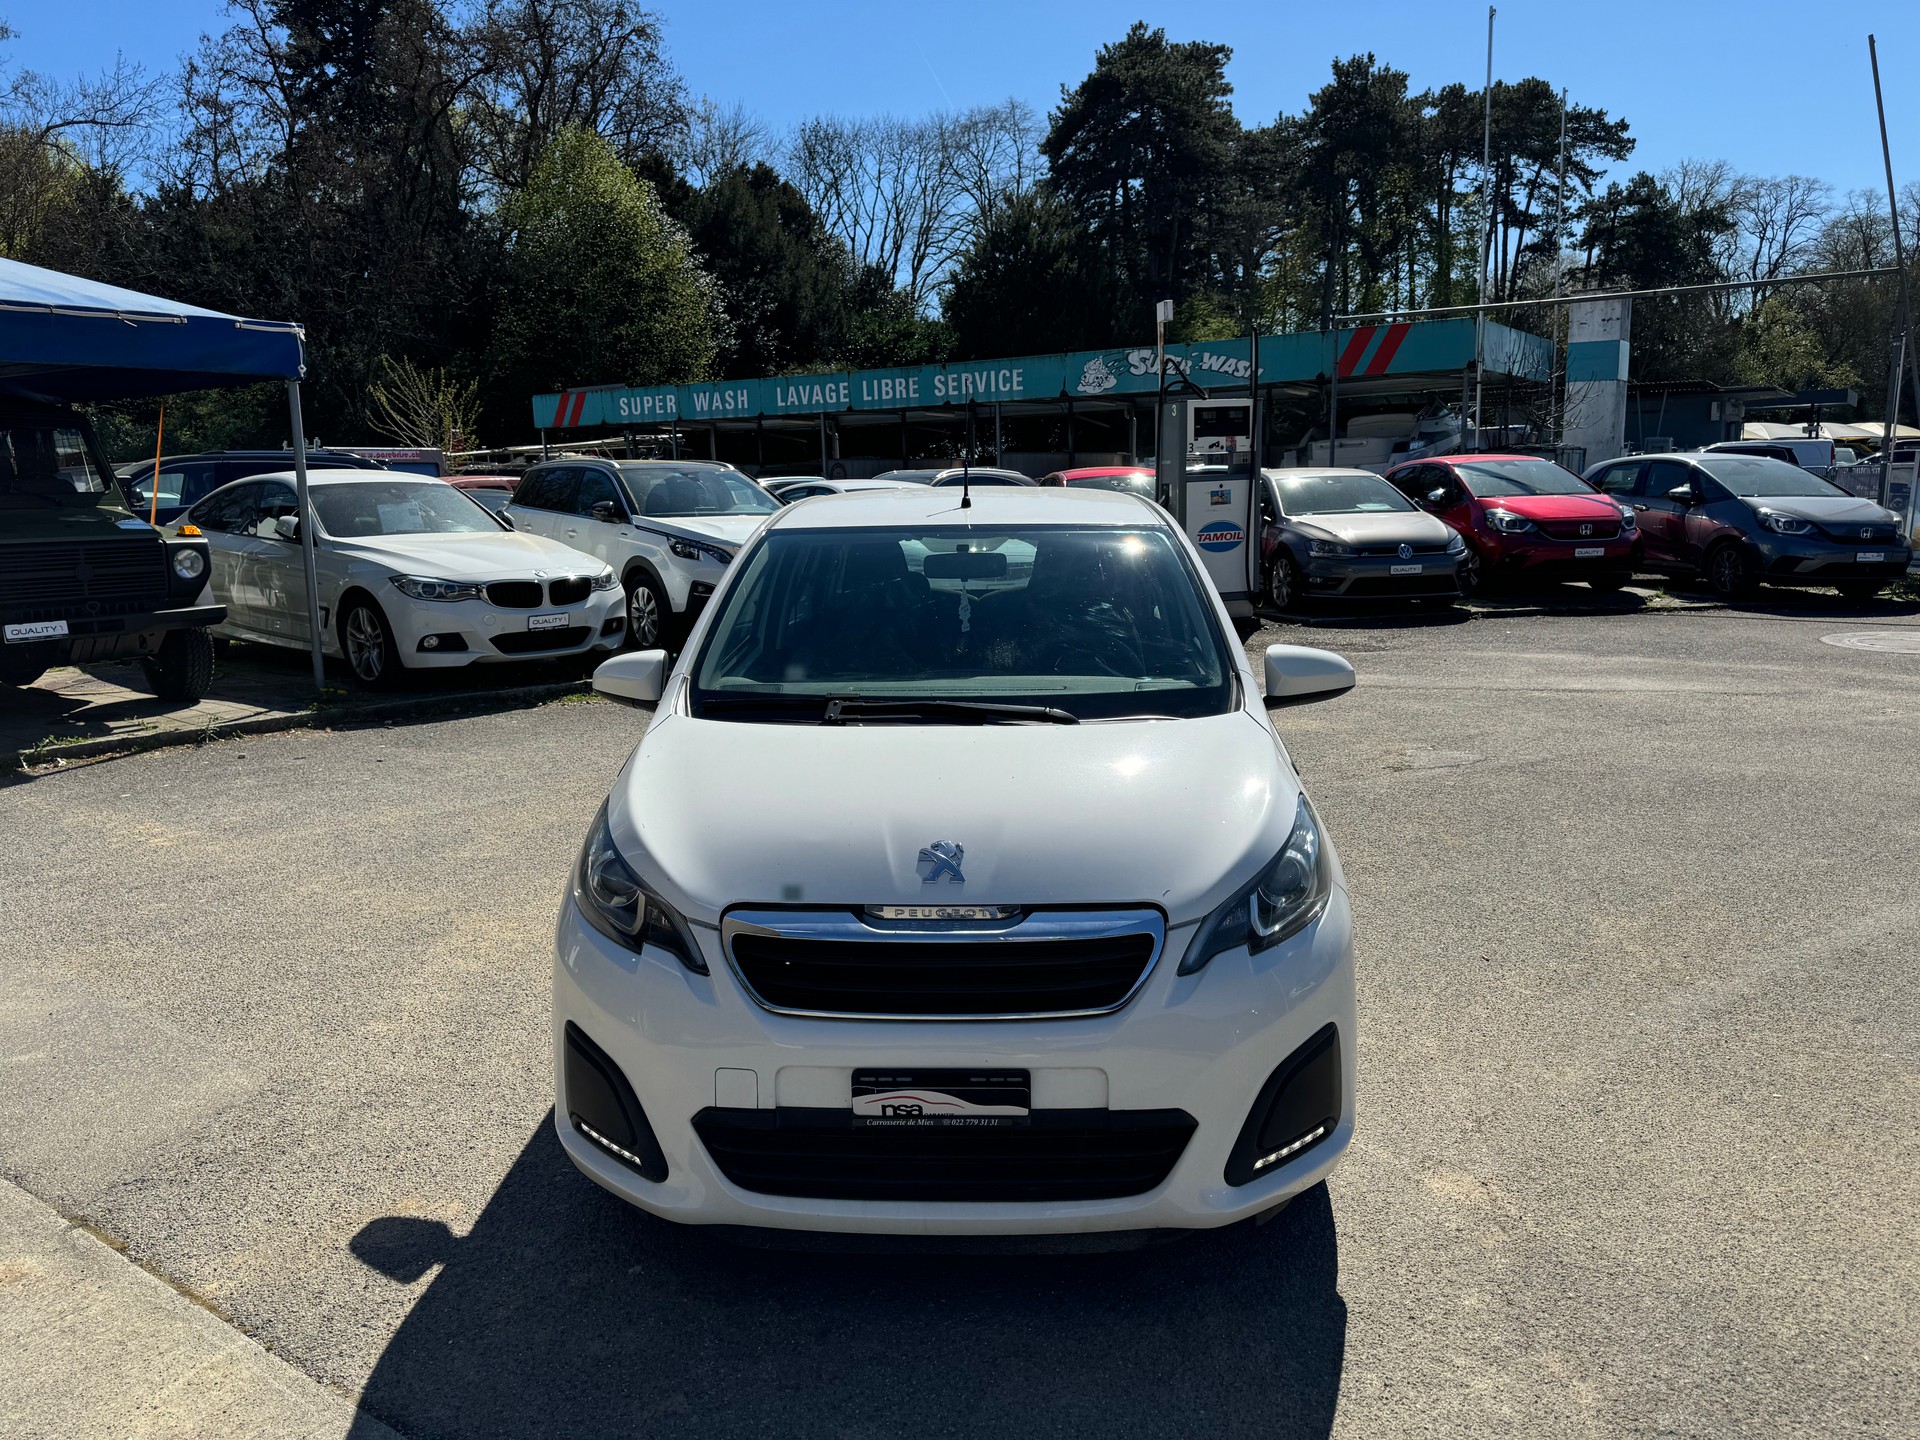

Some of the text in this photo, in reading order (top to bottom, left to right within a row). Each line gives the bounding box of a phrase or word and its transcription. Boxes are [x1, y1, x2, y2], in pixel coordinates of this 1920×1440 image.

[619, 368, 1024, 416] SUPER WASH LAVAGE LIBRE SERVICE
[1171, 404, 1177, 417] 3
[1188, 442, 1194, 453] 3
[1196, 531, 1244, 542] TAMOIL
[532, 617, 563, 625] QUALITY
[11, 625, 57, 636] QUALITY
[894, 908, 988, 918] PEUGEOT
[881, 1104, 923, 1117] nsa
[866, 1118, 998, 1126] Carrosserie de Mies 022 779 31 31
